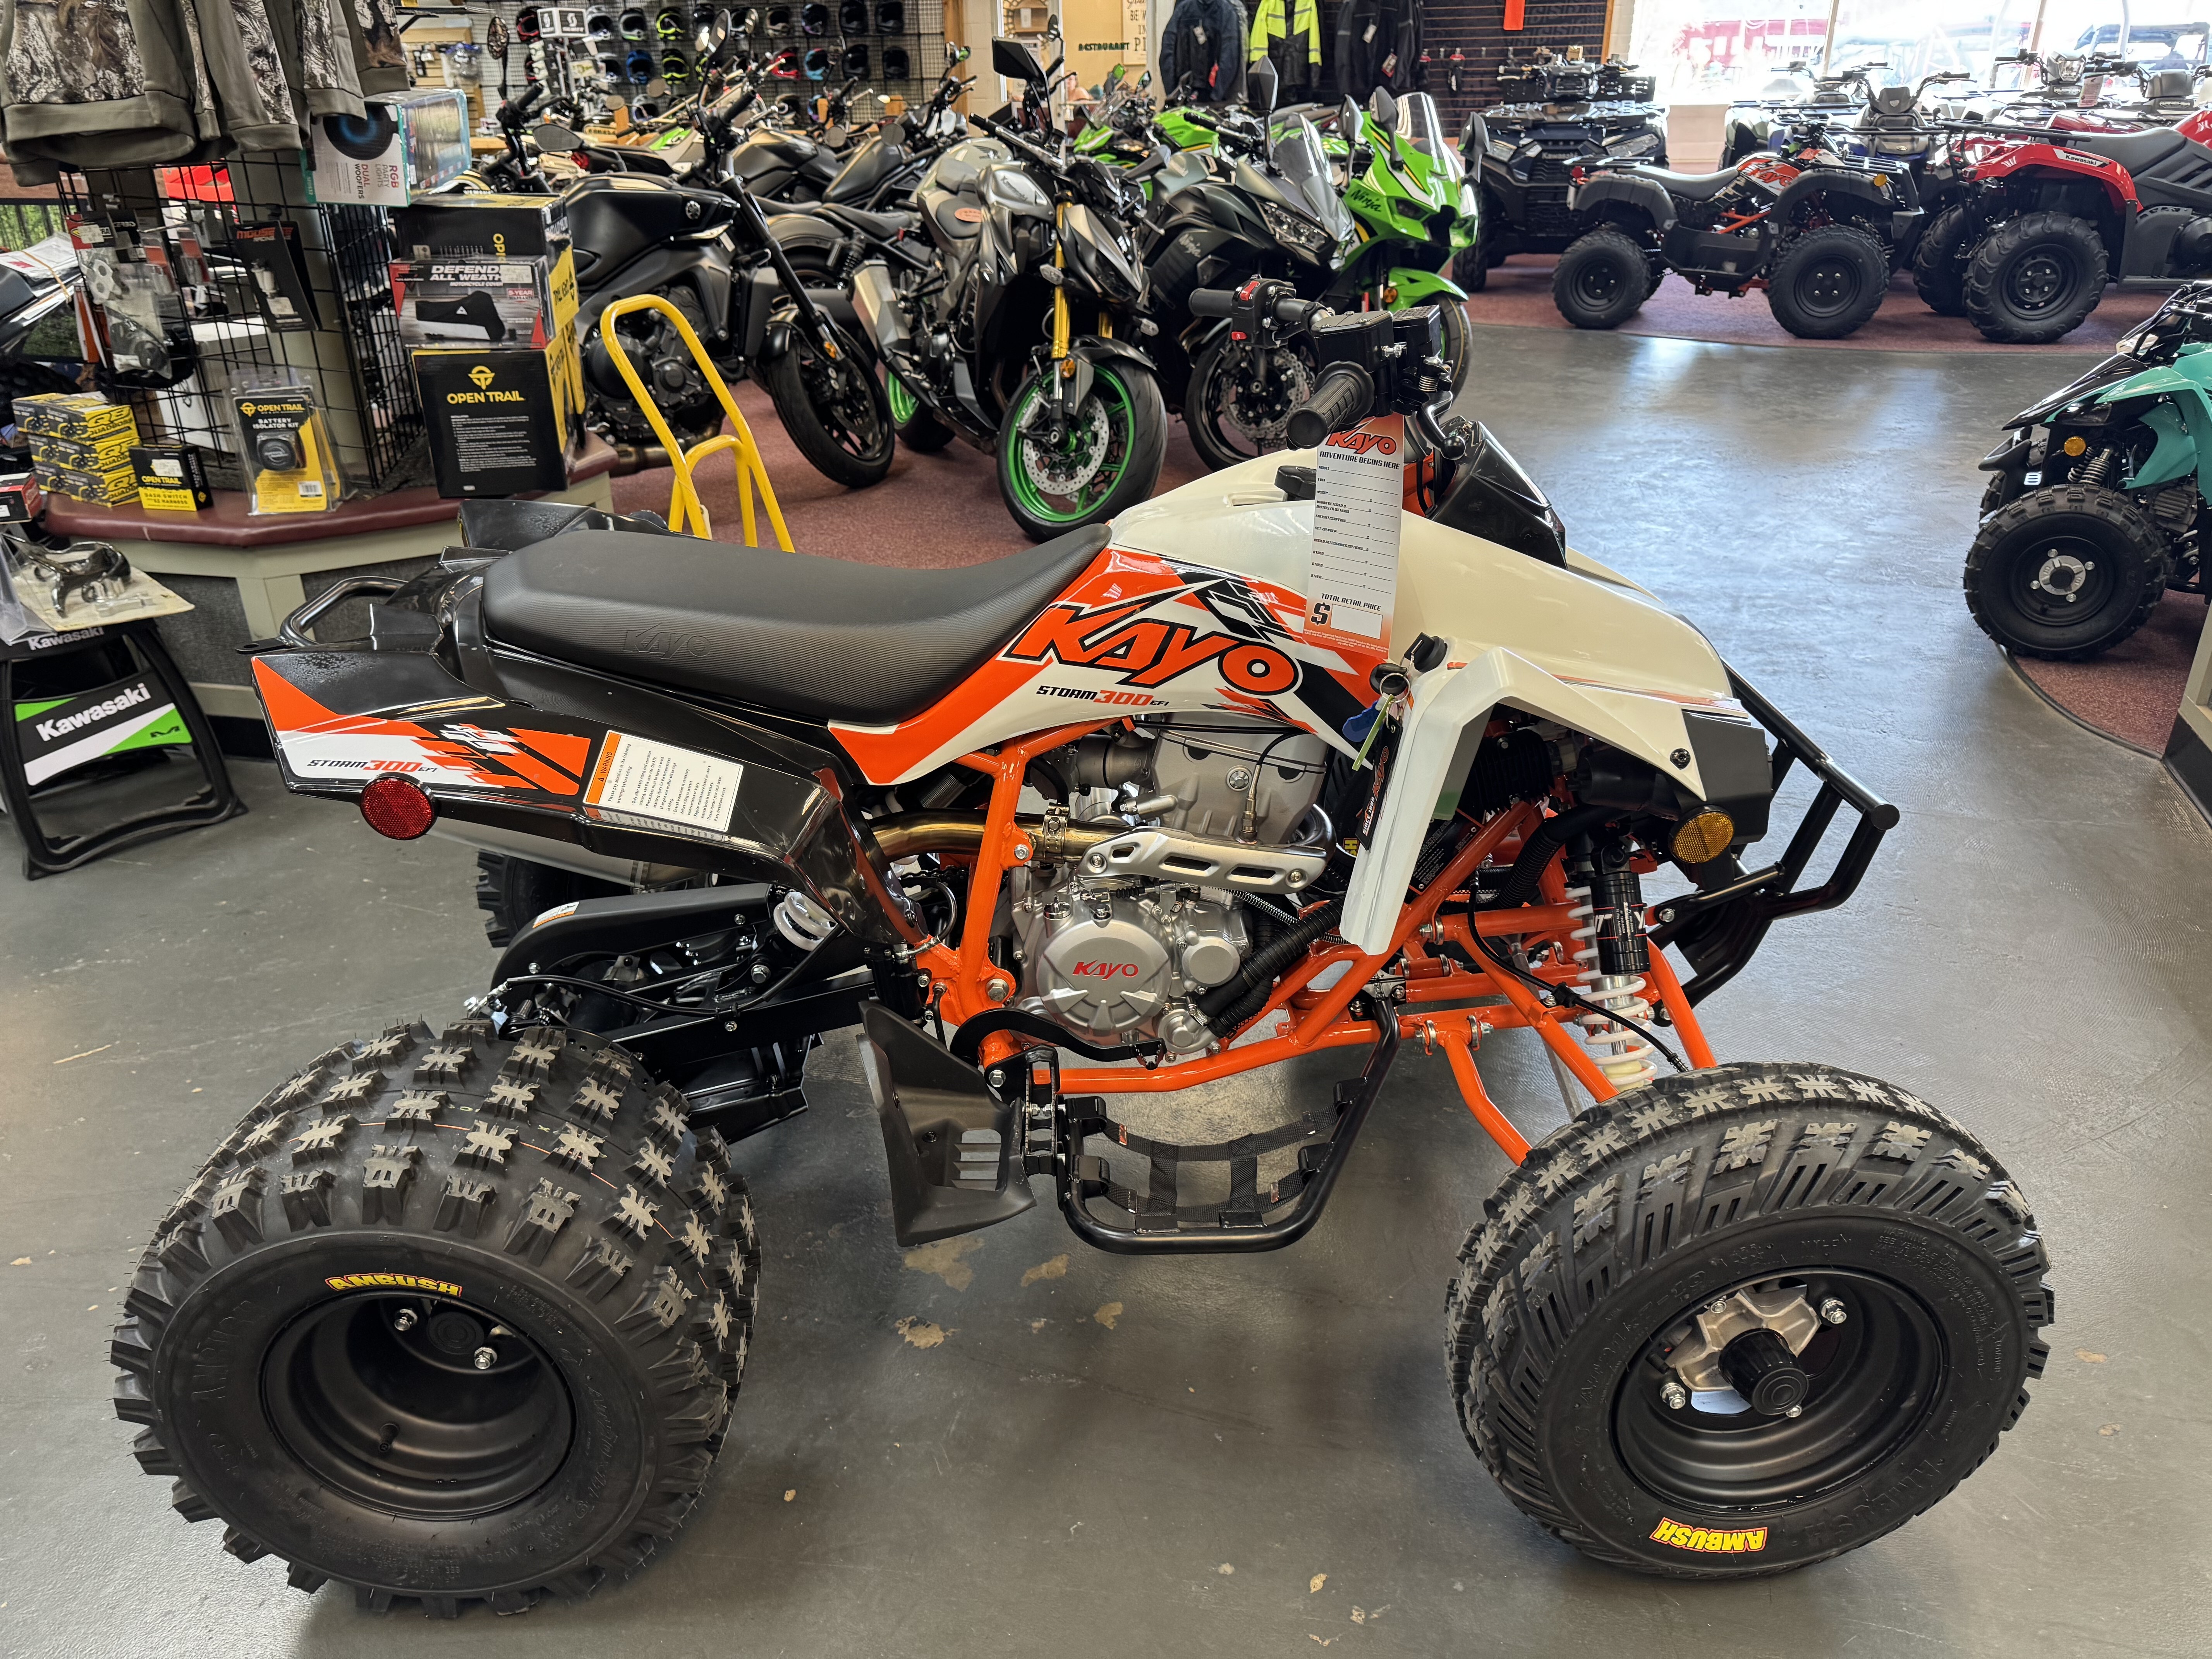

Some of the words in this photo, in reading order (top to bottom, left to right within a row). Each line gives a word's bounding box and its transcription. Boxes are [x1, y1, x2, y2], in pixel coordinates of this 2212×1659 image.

[2065, 154, 2097, 165] Kawasaki
[354, 163, 364, 199] WOOFERS
[361, 164, 370, 187] DUAL
[375, 164, 384, 188] LIGHTS
[382, 164, 390, 188] PARTY
[389, 165, 399, 188] RGB
[1350, 188, 1382, 213] Ninja
[431, 265, 501, 274] DEFEND
[447, 392, 486, 404] OPEN
[486, 390, 525, 402] TRAIL
[1325, 424, 1397, 455] KAYO
[1319, 451, 1358, 462] ADVENTURE
[1358, 456, 1383, 467] BEGINS
[1383, 461, 1400, 470] HERE
[160, 476, 183, 484] TRAIL
[1310, 602, 1331, 625] $
[1321, 593, 1340, 602] TOTAL
[1341, 598, 1362, 607] RETAIL
[1363, 602, 1381, 611] PRICE
[27, 626, 105, 651] Kawasaki
[622, 623, 712, 660] KAYO
[1000, 584, 1299, 696] KAYO
[35, 683, 151, 742] Kawasaki
[601, 752, 613, 774] WARNING
[1072, 959, 1139, 981] KAYO
[326, 1273, 462, 1297] AMBUSH
[1652, 1517, 1769, 1554] AMBUSH
